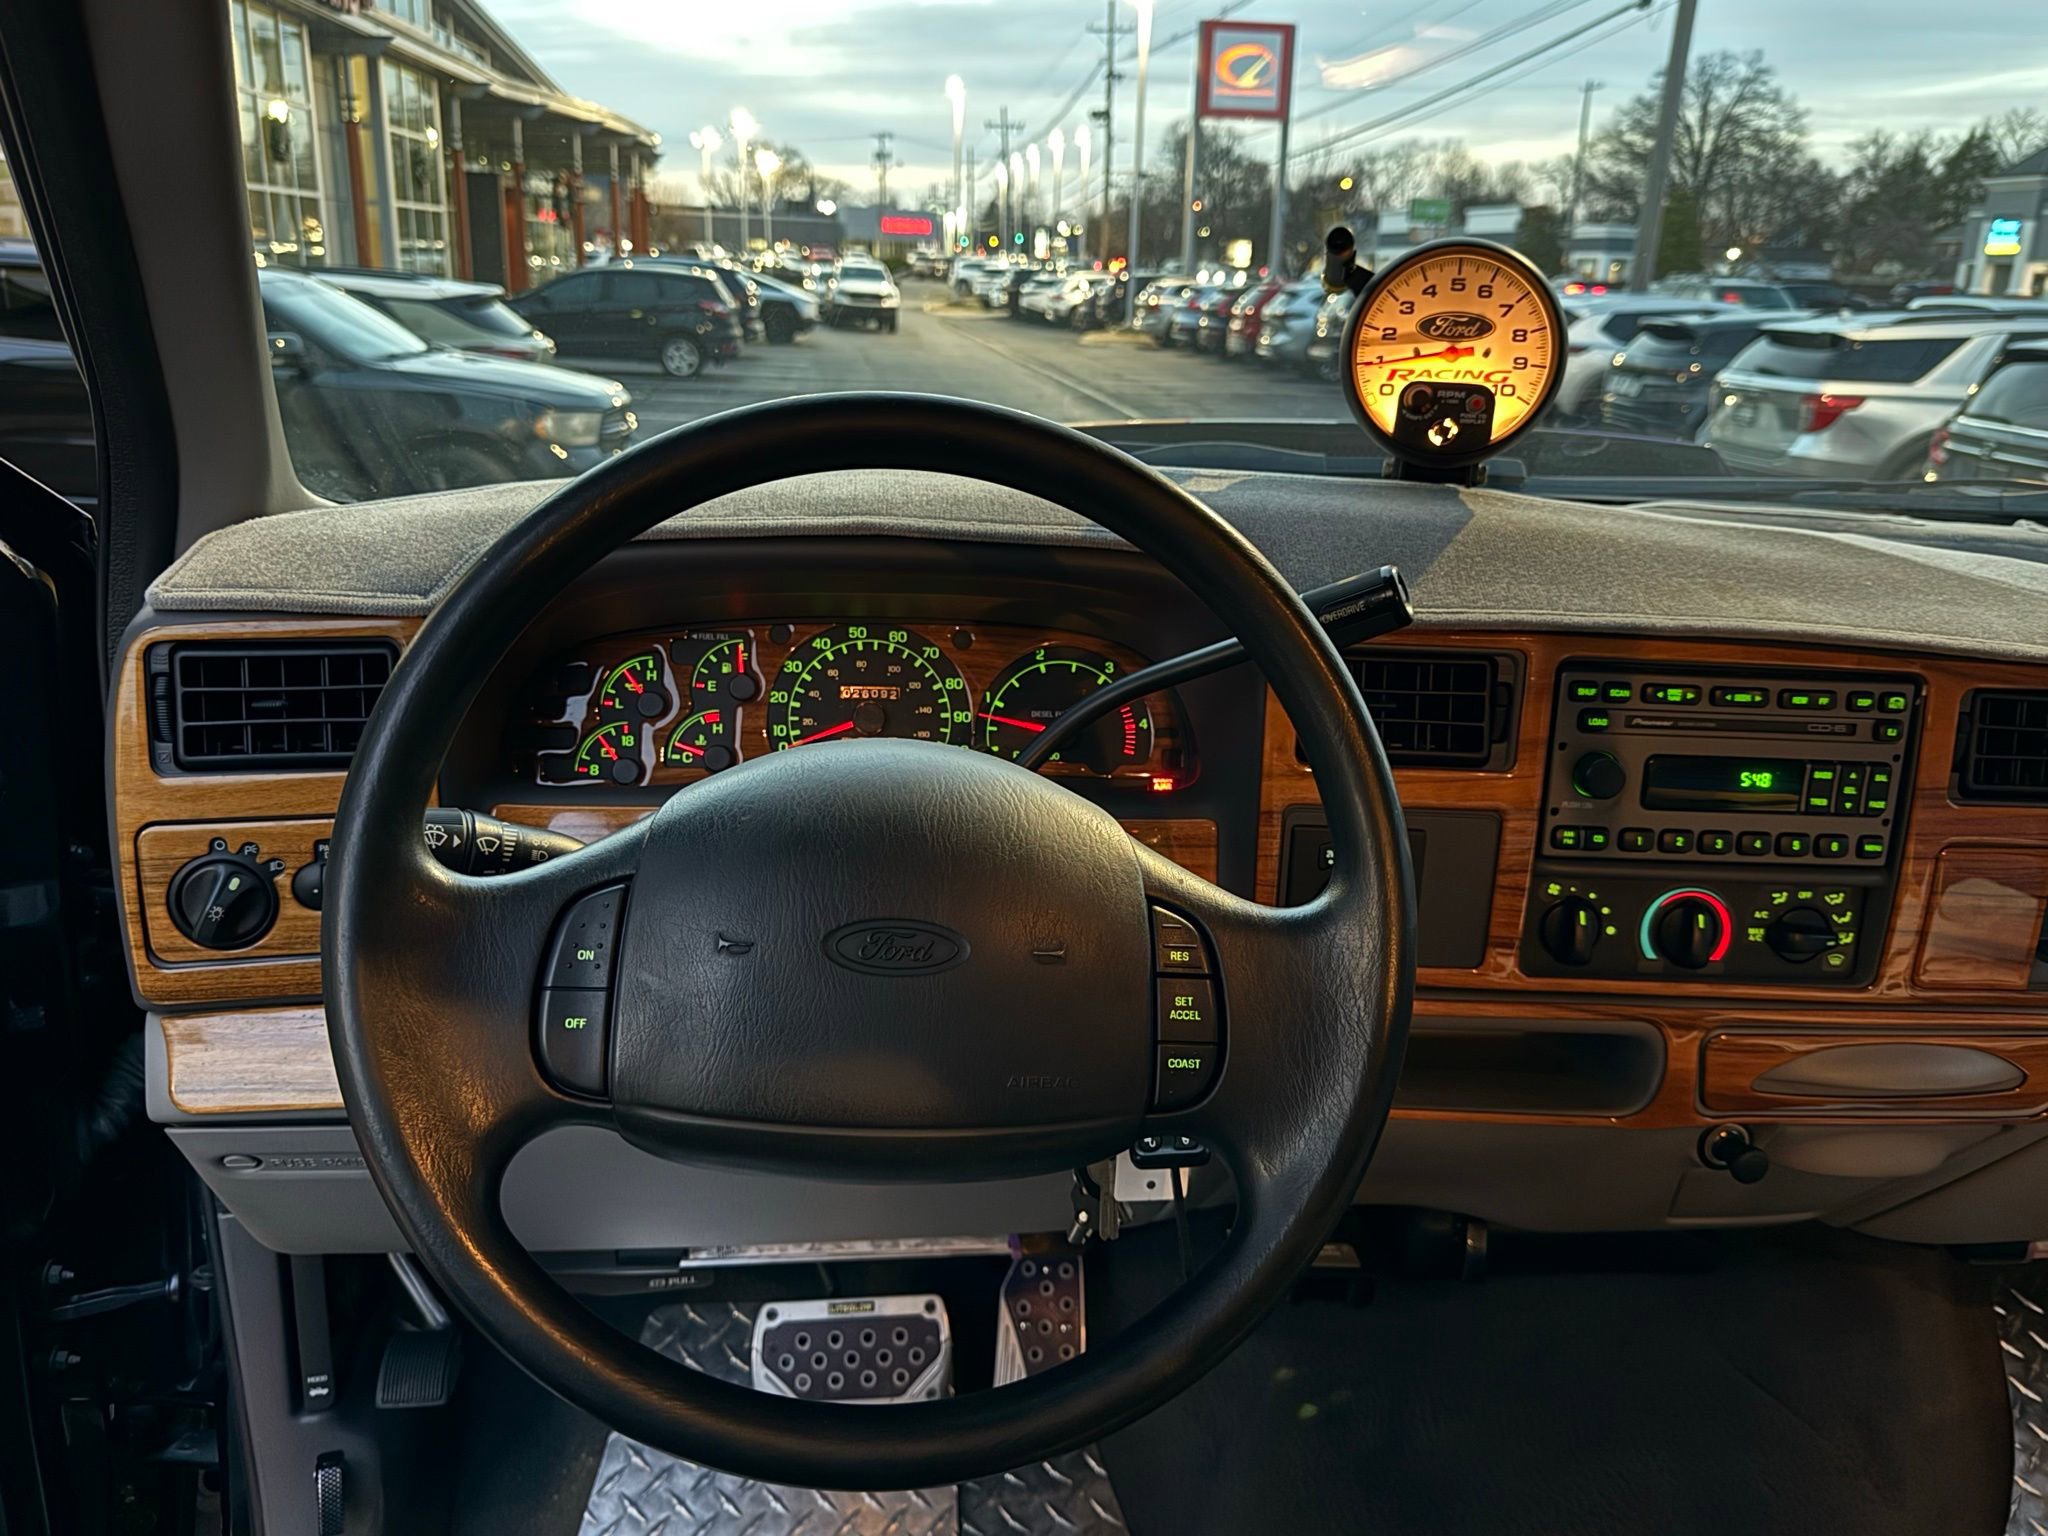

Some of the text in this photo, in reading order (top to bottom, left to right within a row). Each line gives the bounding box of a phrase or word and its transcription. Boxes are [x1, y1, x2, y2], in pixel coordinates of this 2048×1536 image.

[1421, 284, 1438, 298] 4
[1450, 278, 1466, 292] 5
[1477, 284, 1493, 299] 6
[1399, 301, 1415, 315] 3
[1498, 304, 1514, 318] 7
[1429, 315, 1480, 337] Ford
[1381, 327, 1397, 341] 2
[1512, 329, 1528, 343] 8
[1513, 356, 1529, 370] 9
[1385, 368, 1513, 383] RACING
[1379, 383, 1395, 396] 0
[1436, 390, 1466, 399] RPM
[1492, 383, 1516, 397] 10
[848, 627, 868, 639] 50
[888, 631, 908, 643] 60
[812, 638, 831, 650] 40
[922, 647, 940, 659] 70
[1035, 649, 1045, 661] 2
[783, 661, 803, 673] 30
[856, 660, 867, 668] 80
[887, 665, 901, 673] 100
[1104, 662, 1114, 674] 3
[646, 670, 657, 681] H
[827, 669, 839, 677] 60
[707, 680, 717, 692] E
[945, 678, 964, 690] 80
[769, 691, 788, 703] 20
[808, 690, 820, 698] 40
[985, 692, 991, 703] 1
[1609, 688, 1630, 697] SCAN
[614, 699, 624, 709] L
[953, 711, 972, 723] 90
[1031, 710, 1053, 718] DIESEL
[802, 718, 814, 726] 20
[1138, 718, 1149, 730] 4
[1588, 717, 1609, 726] LOAD
[712, 723, 723, 734] H
[773, 725, 787, 737] 10
[621, 735, 635, 747] 18
[682, 752, 693, 764] C
[589, 764, 600, 776] 8
[1740, 771, 1772, 788] 5:48
[1637, 835, 1643, 846] 1
[1675, 836, 1684, 847] 2
[1714, 839, 1723, 849] 3
[1753, 839, 1762, 849] 4
[1792, 840, 1801, 851] 5
[1830, 841, 1839, 852] 6
[859, 930, 936, 962] Ford
[577, 949, 595, 961] ON
[1170, 951, 1190, 962] RES
[1175, 996, 1194, 1007] SET
[1169, 1010, 1201, 1021] ACCEL
[564, 1018, 588, 1029] OFF
[1168, 1058, 1201, 1069] COAST
